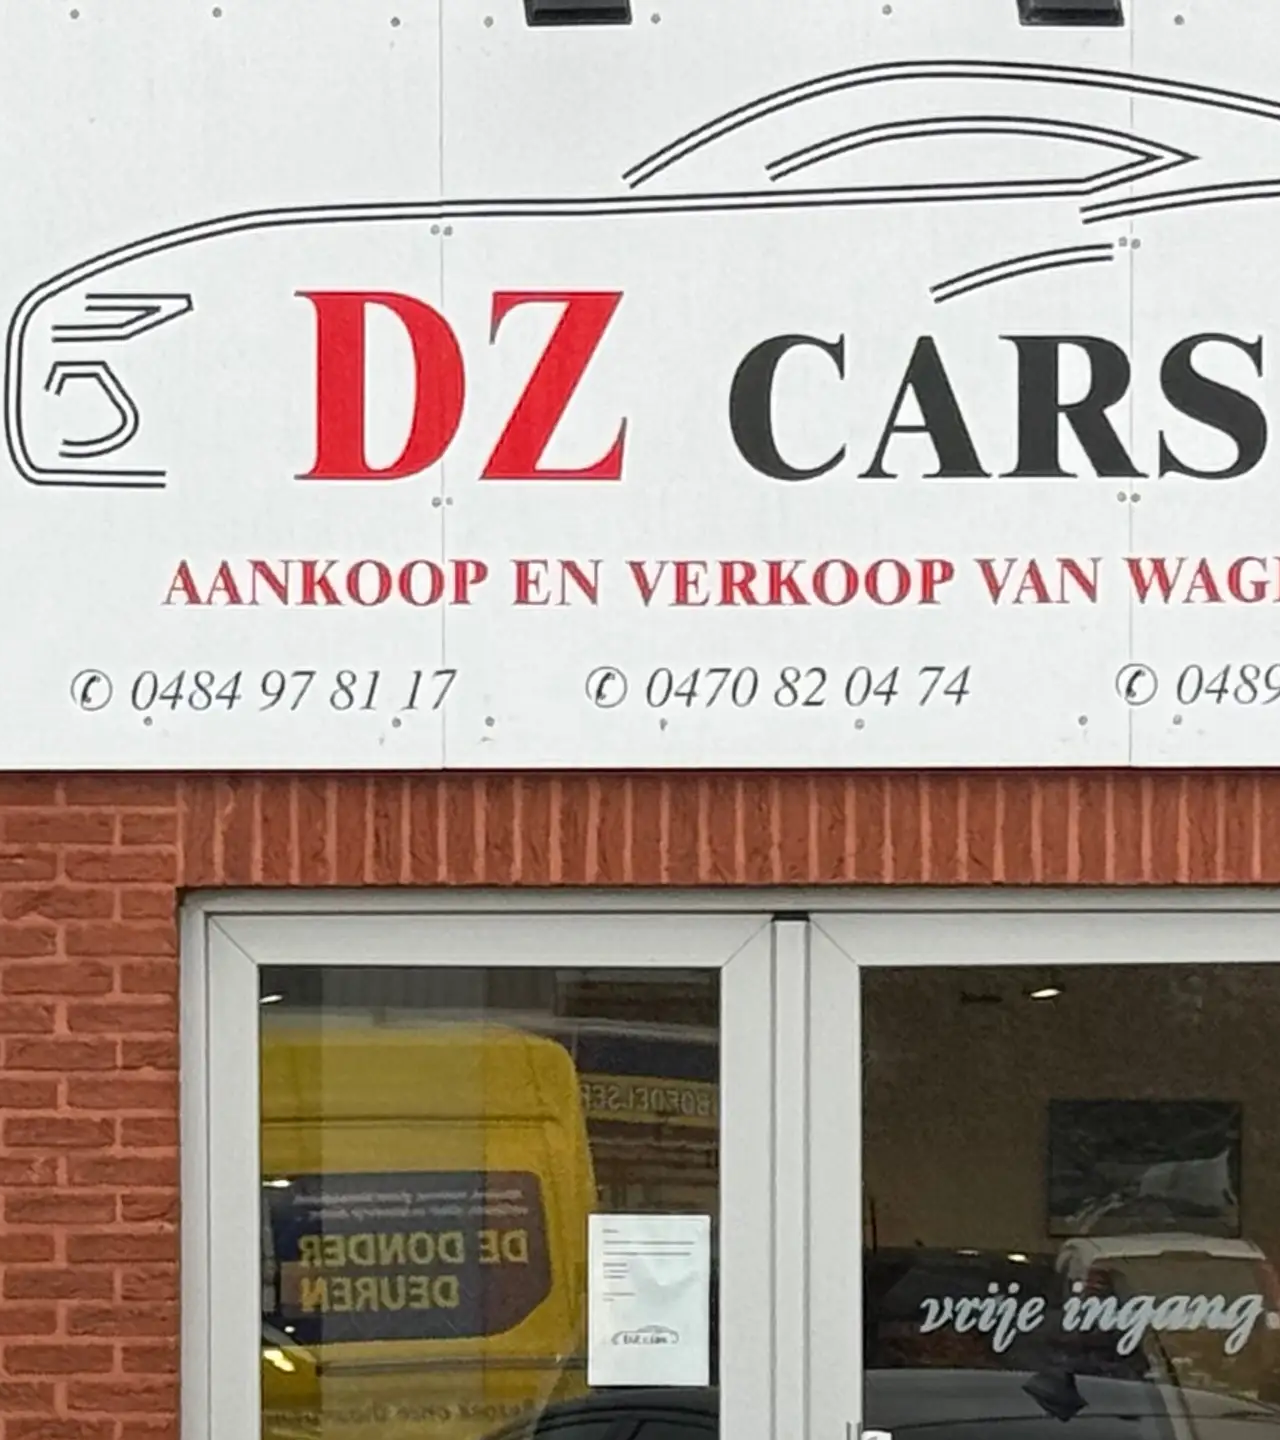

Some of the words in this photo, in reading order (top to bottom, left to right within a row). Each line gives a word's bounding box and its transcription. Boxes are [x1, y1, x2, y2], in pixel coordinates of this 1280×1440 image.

[295, 290, 628, 482] DZ
[727, 332, 1268, 482] CARS
[164, 559, 488, 607] AANKOOP
[513, 559, 601, 605] EN
[629, 559, 955, 606] VERKOOP
[977, 558, 1098, 604] VAN
[131, 670, 243, 710] 0484
[261, 670, 316, 711] 97
[333, 670, 380, 710] 81
[405, 669, 458, 710] 17
[646, 667, 758, 707] 0470
[774, 667, 827, 707] 82
[845, 666, 899, 706] 04
[920, 666, 971, 705] 74
[919, 1283, 1045, 1352] vrije
